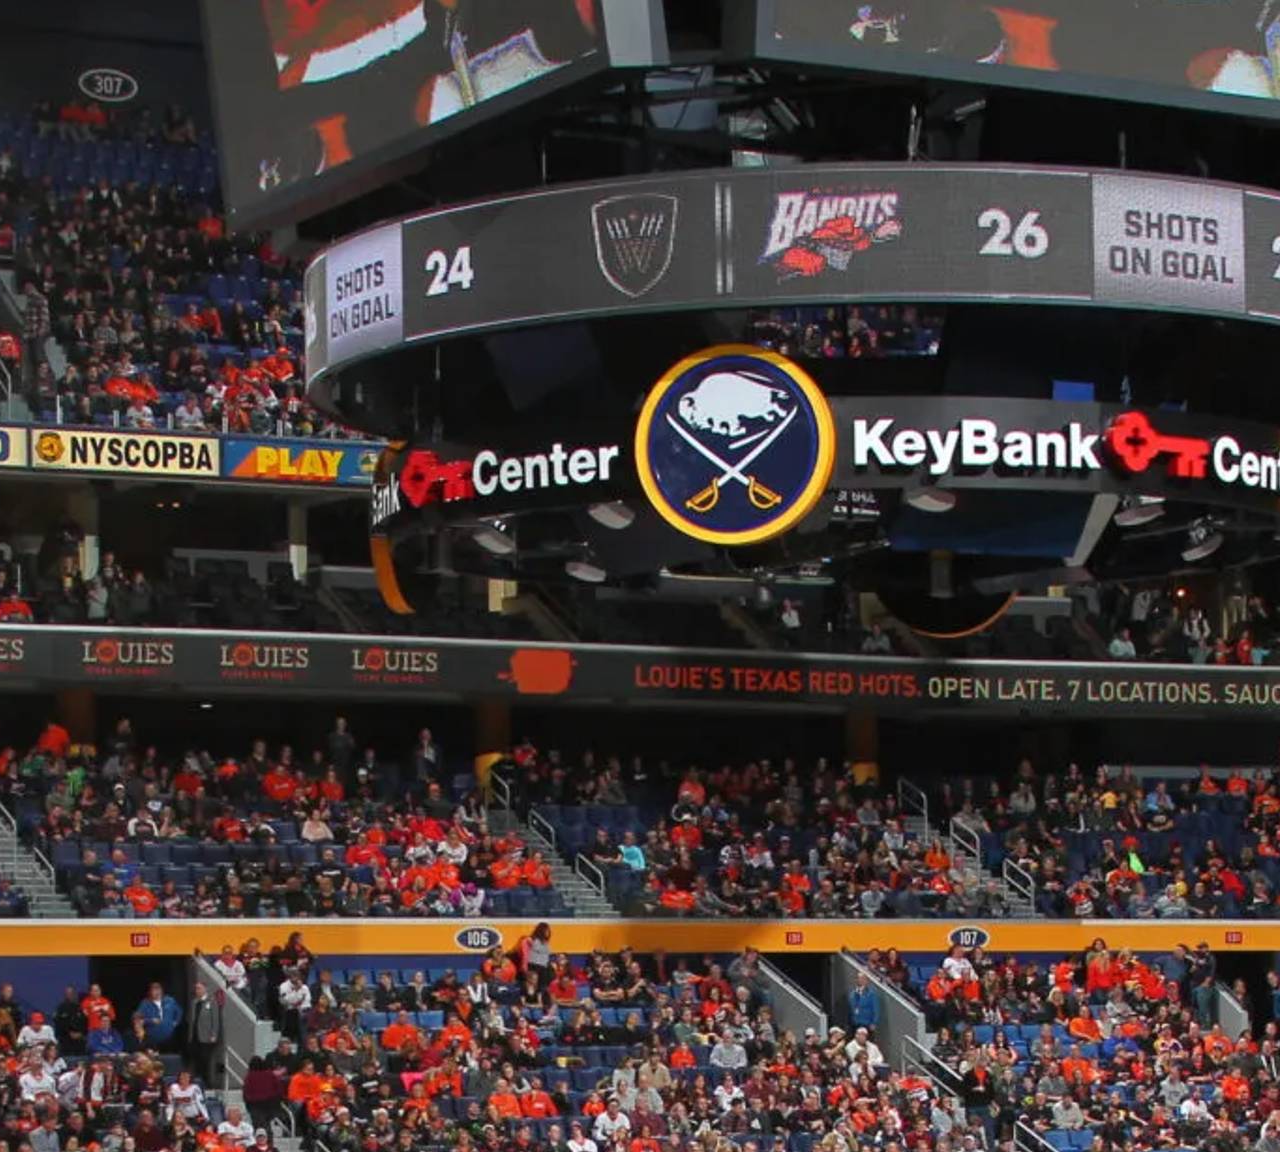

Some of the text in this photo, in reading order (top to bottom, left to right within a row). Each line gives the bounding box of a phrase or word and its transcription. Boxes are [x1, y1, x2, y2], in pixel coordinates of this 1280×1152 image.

[94, 76, 122, 94] 307
[977, 207, 1049, 258] 26
[1125, 210, 1218, 244] SHOTS
[336, 260, 384, 302] SHOTS
[425, 246, 474, 296] 24
[1109, 245, 1235, 284] ON GOAL
[331, 294, 394, 338] ON GOAL
[70, 436, 213, 471] NYSCOPBA
[255, 446, 343, 477] PLAY
[852, 419, 1101, 476] KeyBank
[472, 443, 619, 496] Center
[634, 665, 724, 690] LOUIE'S
[731, 668, 802, 693] TEXAS
[809, 671, 855, 695] RED
[860, 673, 923, 698] HOTS.
[928, 677, 990, 699] OPEN
[997, 678, 1060, 701] LATE.
[1067, 680, 1078, 701] 7
[1086, 679, 1217, 703] LOCATIONS.
[467, 931, 489, 946] 106
[959, 931, 978, 946] 107
